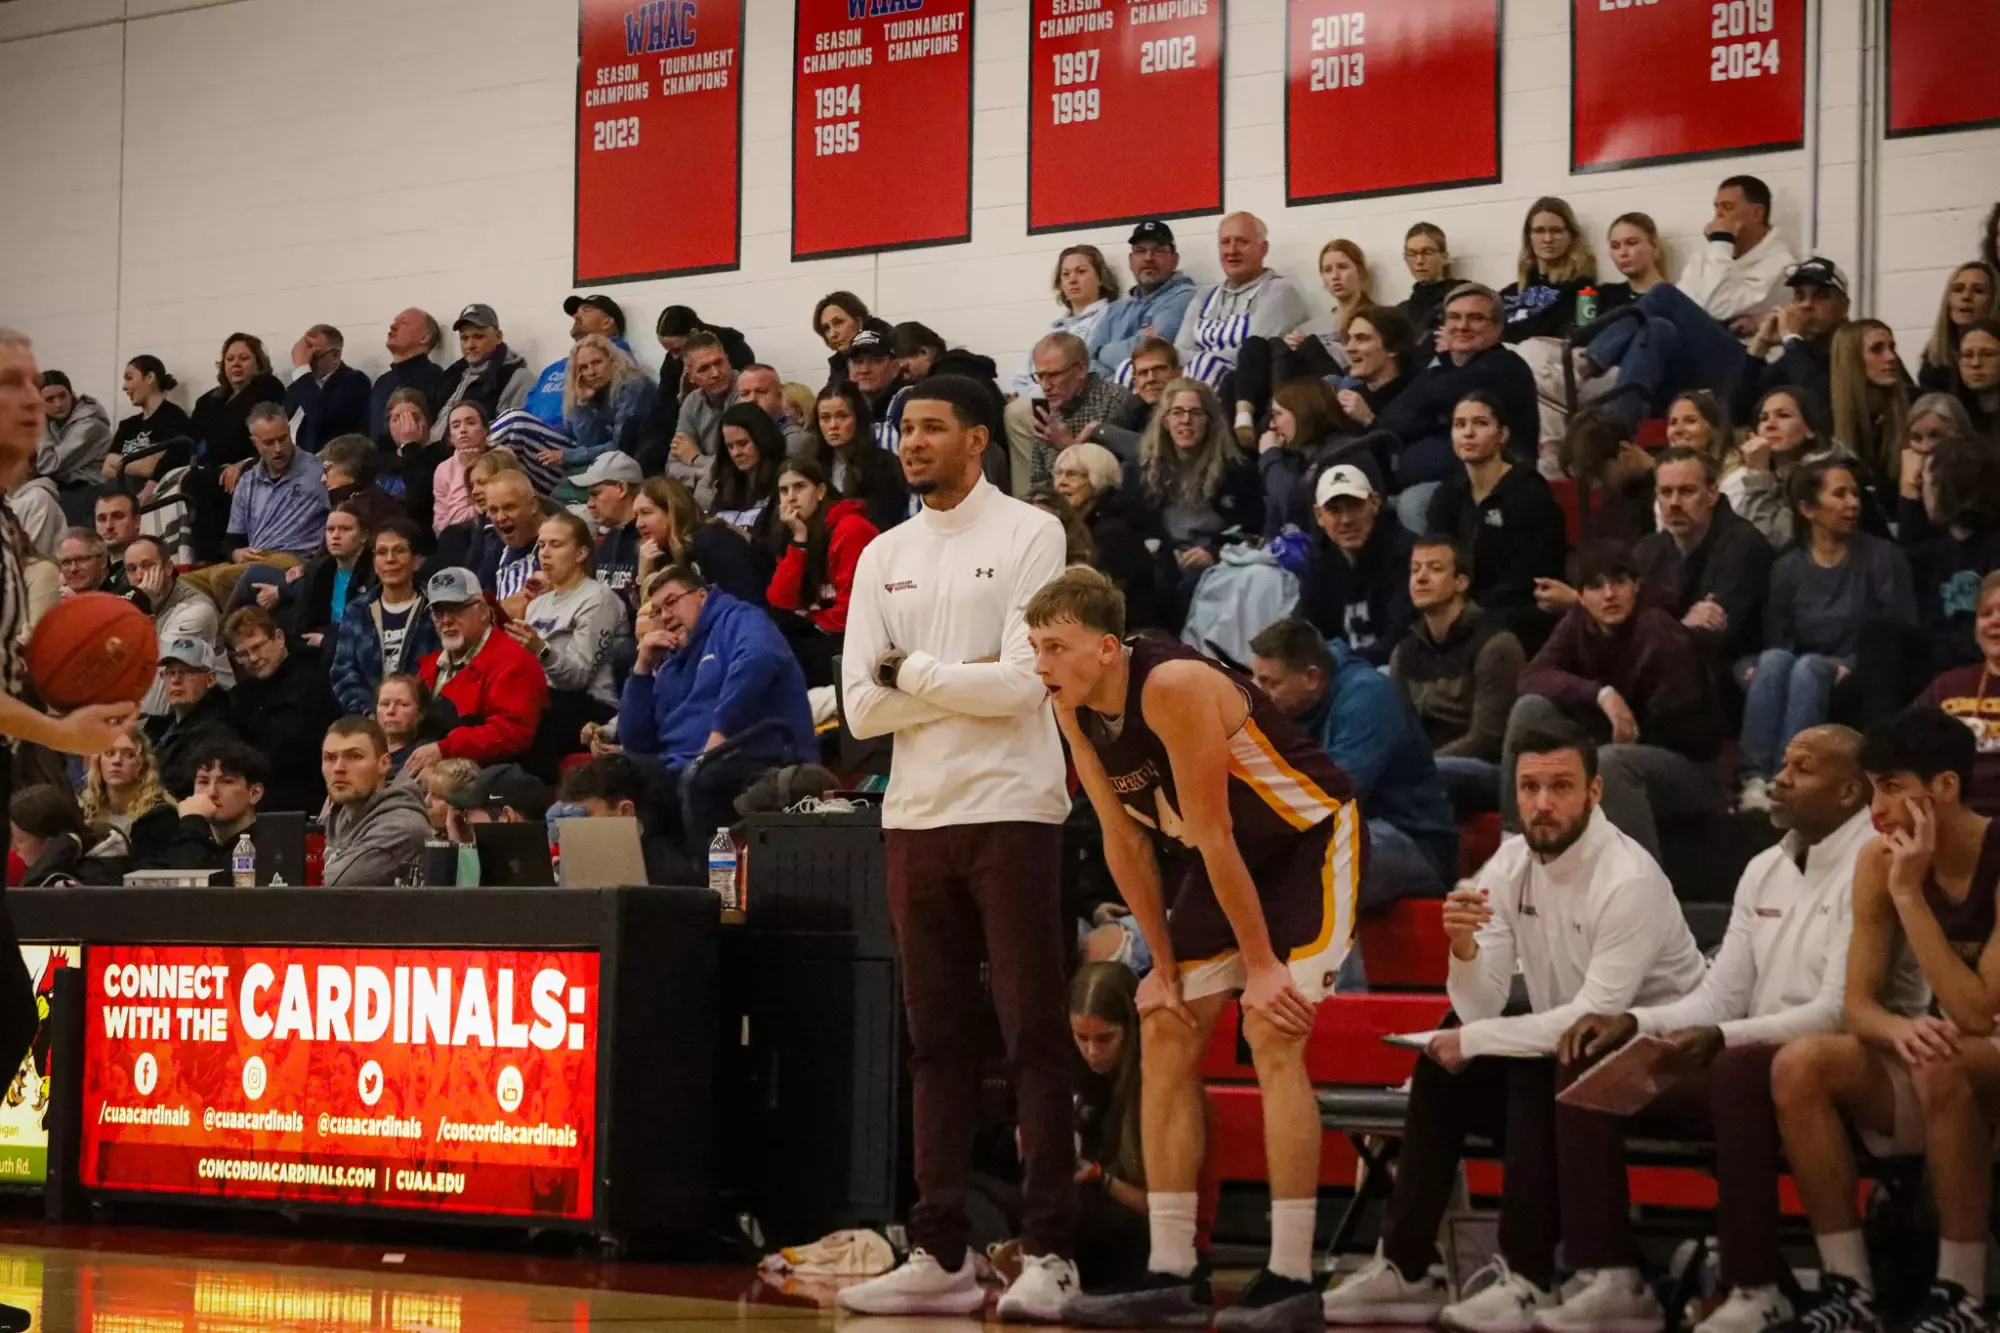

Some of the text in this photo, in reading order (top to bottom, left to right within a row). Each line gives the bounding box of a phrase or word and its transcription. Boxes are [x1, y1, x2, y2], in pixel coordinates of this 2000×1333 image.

[625, 0, 697, 56] WHAC
[884, 12, 964, 41] TOURNAMENT
[1039, 11, 1114, 39] CHAMPIONS
[1130, 0, 1208, 25] CHAMPIONS
[1711, 0, 1774, 39] 2019
[815, 28, 862, 51] SEASON
[887, 34, 958, 62] CHAMPIONS
[1311, 12, 1365, 51] 2012
[658, 49, 734, 76] TOURNAMENT
[803, 47, 873, 74] CHAMPIONS
[1052, 49, 1101, 86] 1997
[1140, 35, 1196, 74] 2002
[1710, 39, 1780, 81] 2024
[596, 63, 640, 86] SEASON
[663, 70, 729, 96] CHAMPIONS
[1310, 53, 1365, 92] 2013
[585, 82, 649, 107] CHAMPIONS
[815, 84, 861, 119] 1994
[1051, 88, 1100, 125] 1999
[594, 116, 640, 151] 2023
[814, 121, 860, 156] 1995
[1583, 303, 1597, 319] G
[103, 964, 229, 1000] CONNECT
[103, 1006, 228, 1041] WITH THE
[240, 963, 585, 1050] CARDINALS:
[98, 1101, 578, 1147] /cuaacardinals @cuaacardinals @cuaacardinals /concordiacardinals
[16, 1158, 31, 1174] Rd.
[198, 1158, 376, 1188] CONCORDIACARDINALS.COM
[396, 1169, 465, 1194] CUAA.EDU
